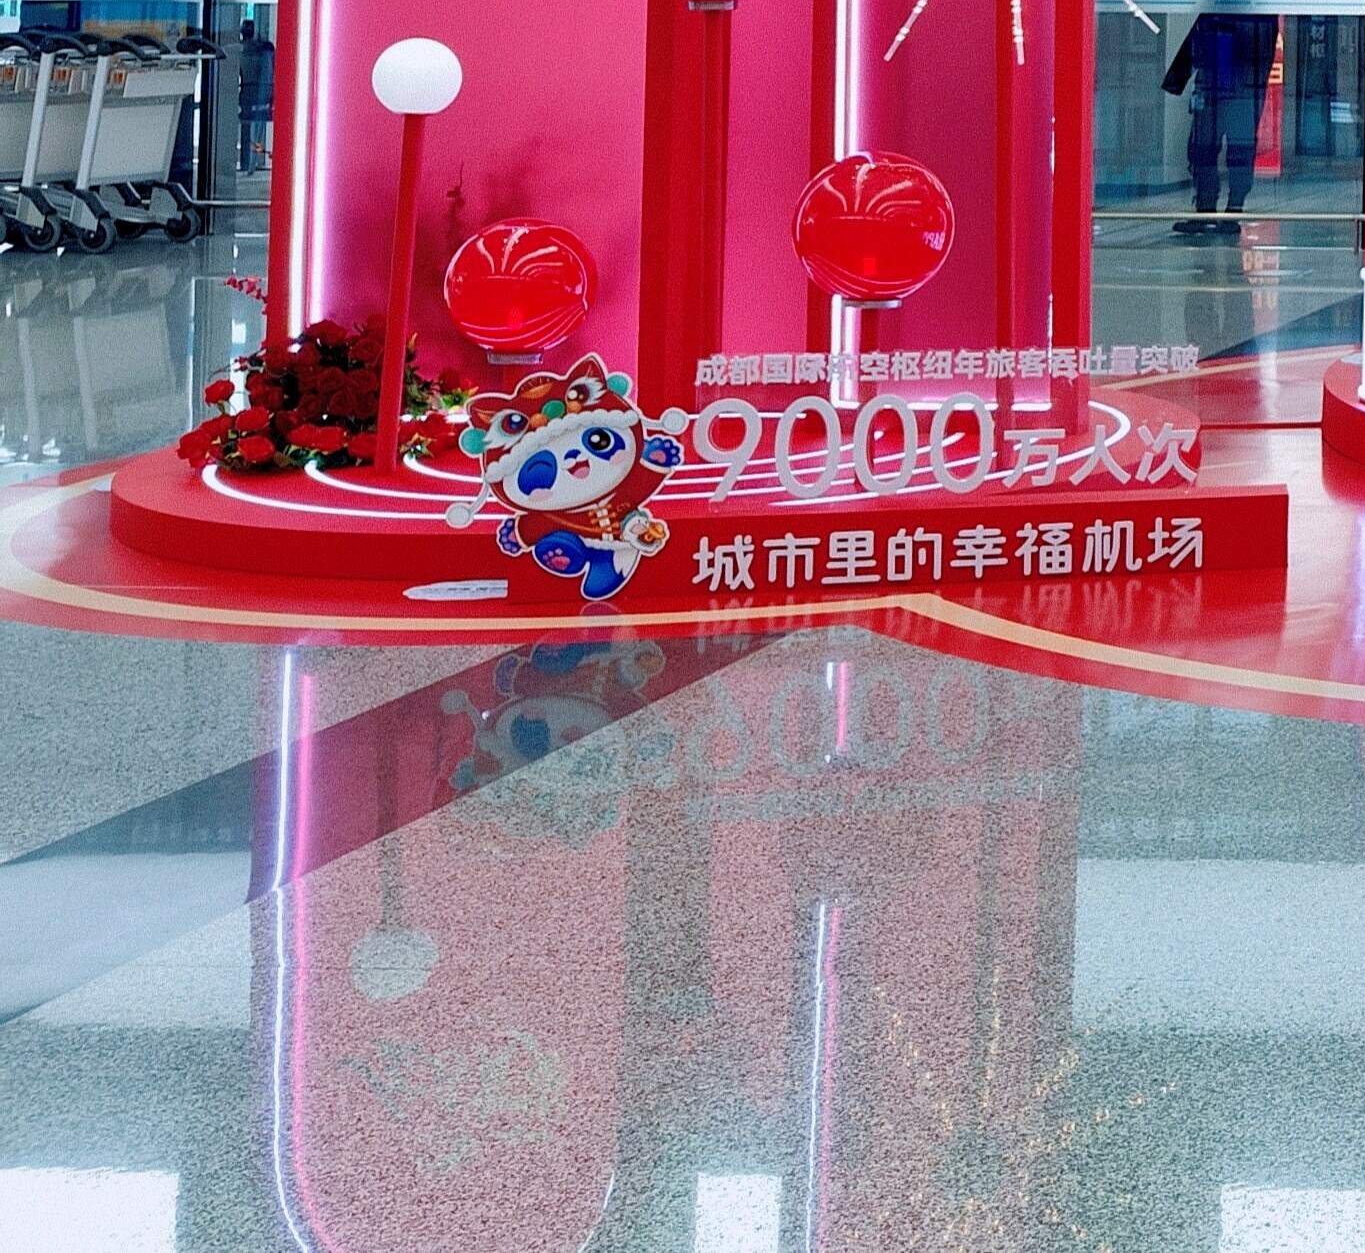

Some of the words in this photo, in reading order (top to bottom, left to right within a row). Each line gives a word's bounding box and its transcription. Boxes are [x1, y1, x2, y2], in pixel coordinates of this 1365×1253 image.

[693, 345, 1201, 387] 成都国际航空枢纽年旅客吞吐量突破
[692, 391, 1199, 504] 9000万人次
[691, 516, 1204, 592] 城市里的幸福机场
